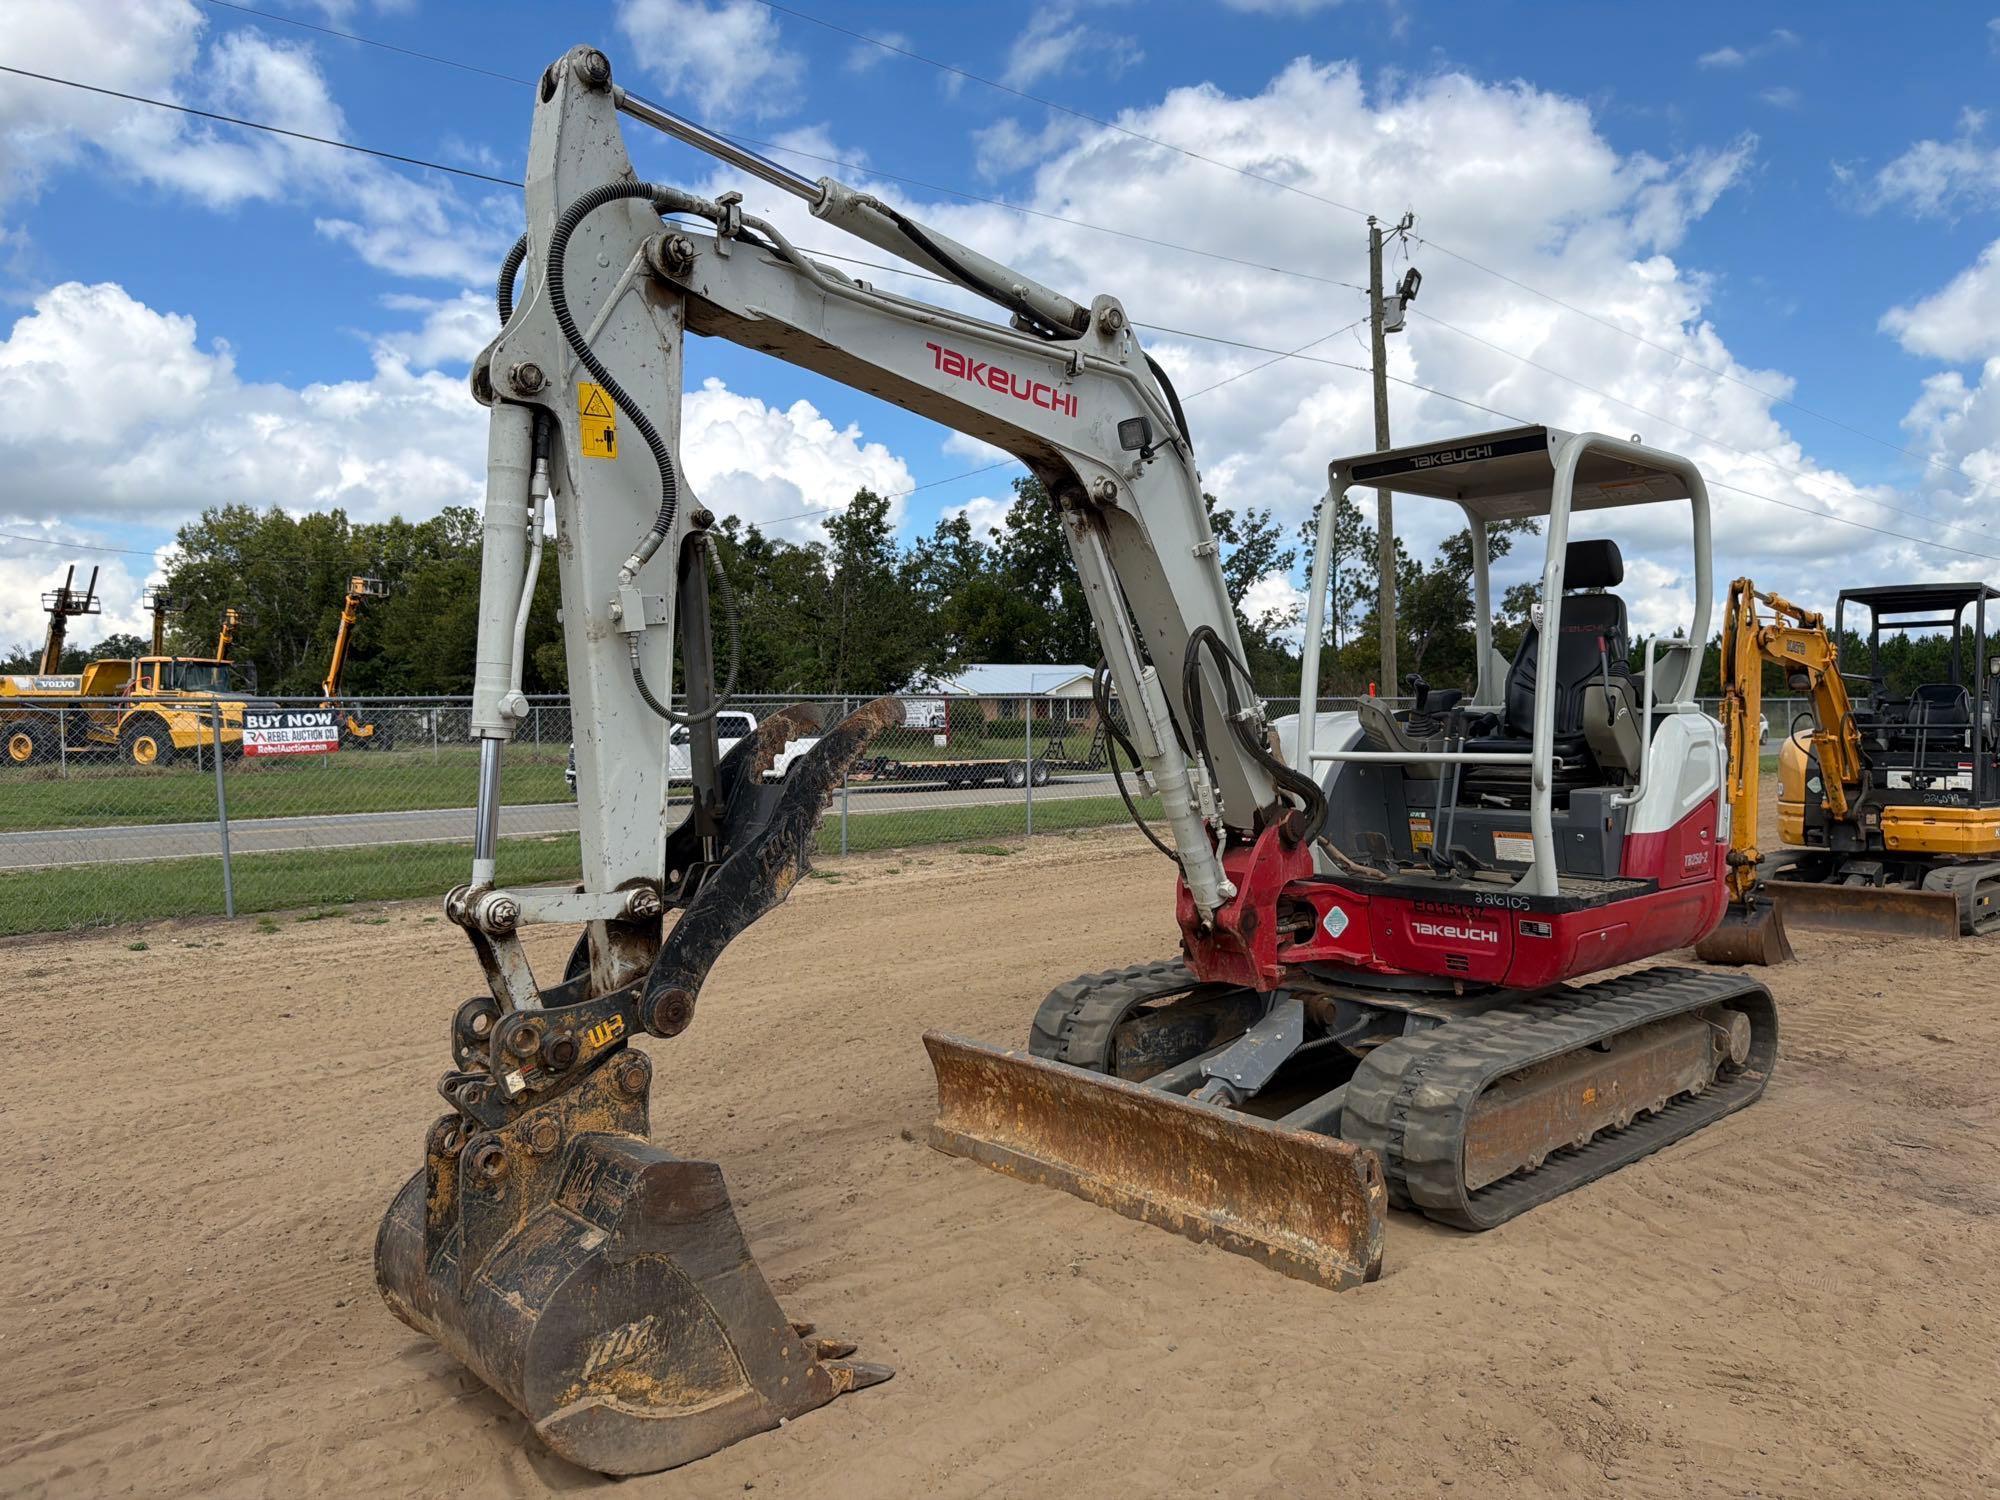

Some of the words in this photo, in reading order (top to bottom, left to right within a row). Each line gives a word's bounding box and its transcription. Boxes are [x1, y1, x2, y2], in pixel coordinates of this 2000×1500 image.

[41, 680, 75, 688] VOLVO
[246, 715, 282, 728] BUY
[287, 713, 332, 727] NOW
[267, 731, 289, 742] REBEL
[292, 729, 322, 741] AUCTION
[1475, 892, 1530, 911] 226105
